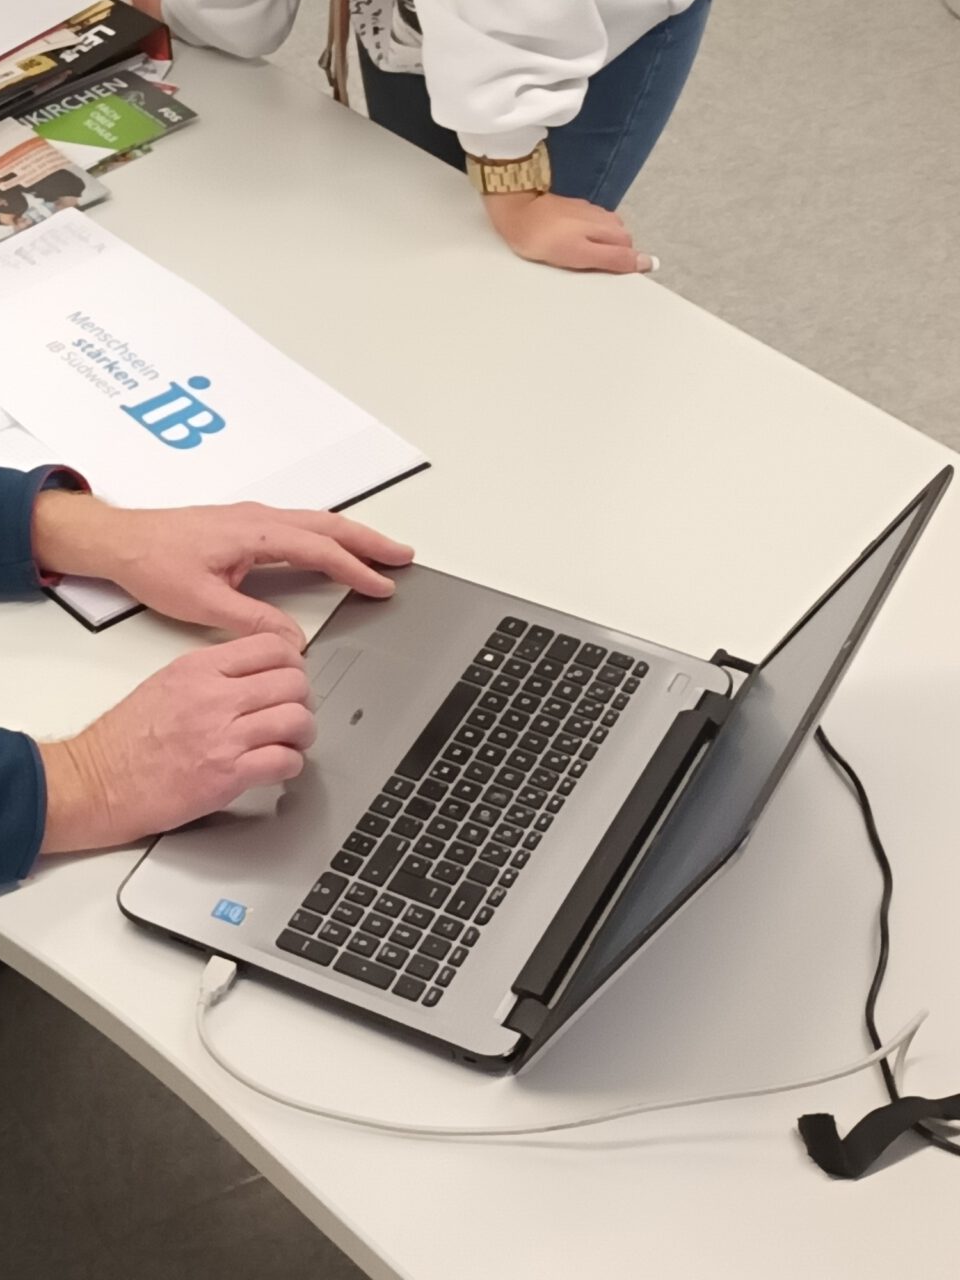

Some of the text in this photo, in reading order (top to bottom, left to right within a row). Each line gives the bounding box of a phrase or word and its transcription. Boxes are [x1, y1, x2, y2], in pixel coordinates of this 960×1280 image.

[66, 310, 160, 382] Menschsein
[72, 337, 139, 391] stärken
[60, 350, 122, 399] Südwest
